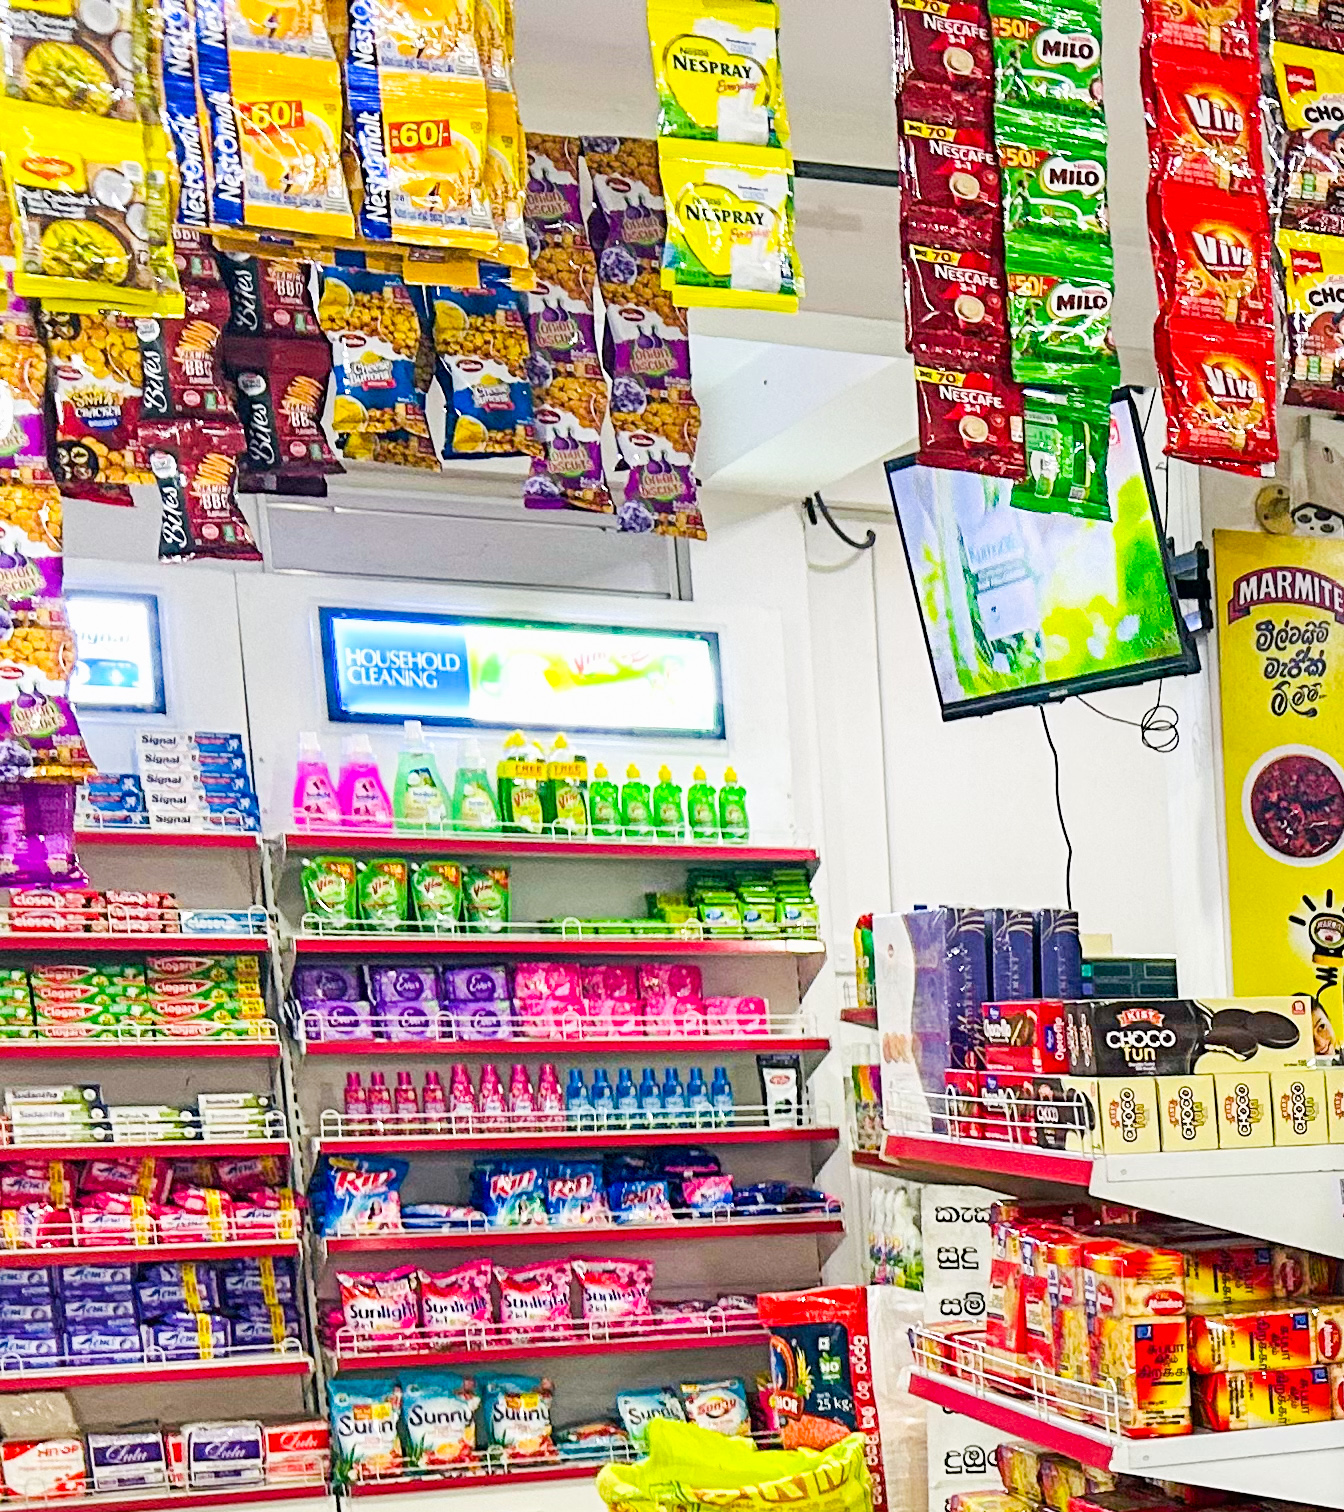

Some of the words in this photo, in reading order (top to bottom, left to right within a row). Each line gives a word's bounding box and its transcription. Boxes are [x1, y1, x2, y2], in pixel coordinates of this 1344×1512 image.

[1042, 40, 1093, 59] MILO
[673, 54, 752, 79] NESPRAY
[1185, 93, 1243, 131] Viva
[400, 121, 448, 147] 60/-
[1049, 167, 1099, 186] MILO
[686, 203, 764, 226] NESPRAY
[1192, 231, 1253, 267] Viva
[1239, 570, 1344, 612] MARMITE
[345, 647, 460, 673] HOUSEHOLD
[348, 667, 438, 689] CLEANING
[142, 735, 176, 745] Signal
[152, 794, 187, 804] Signal
[157, 1002, 199, 1013] Clogard
[1128, 1011, 1154, 1020] KIST
[1105, 1029, 1176, 1048] CHOCO
[1124, 1045, 1155, 1061] fun
[1235, 1083, 1252, 1136] CHOCO
[336, 1169, 397, 1198] Rin
[492, 1169, 537, 1198] Rin
[424, 1297, 488, 1316] Sunlight
[505, 1292, 568, 1310] Sunlight
[409, 1406, 477, 1431] Sunny
[494, 1405, 552, 1427] Sunny
[106, 1445, 147, 1464] Lulu
[202, 1441, 246, 1462] Lulu
